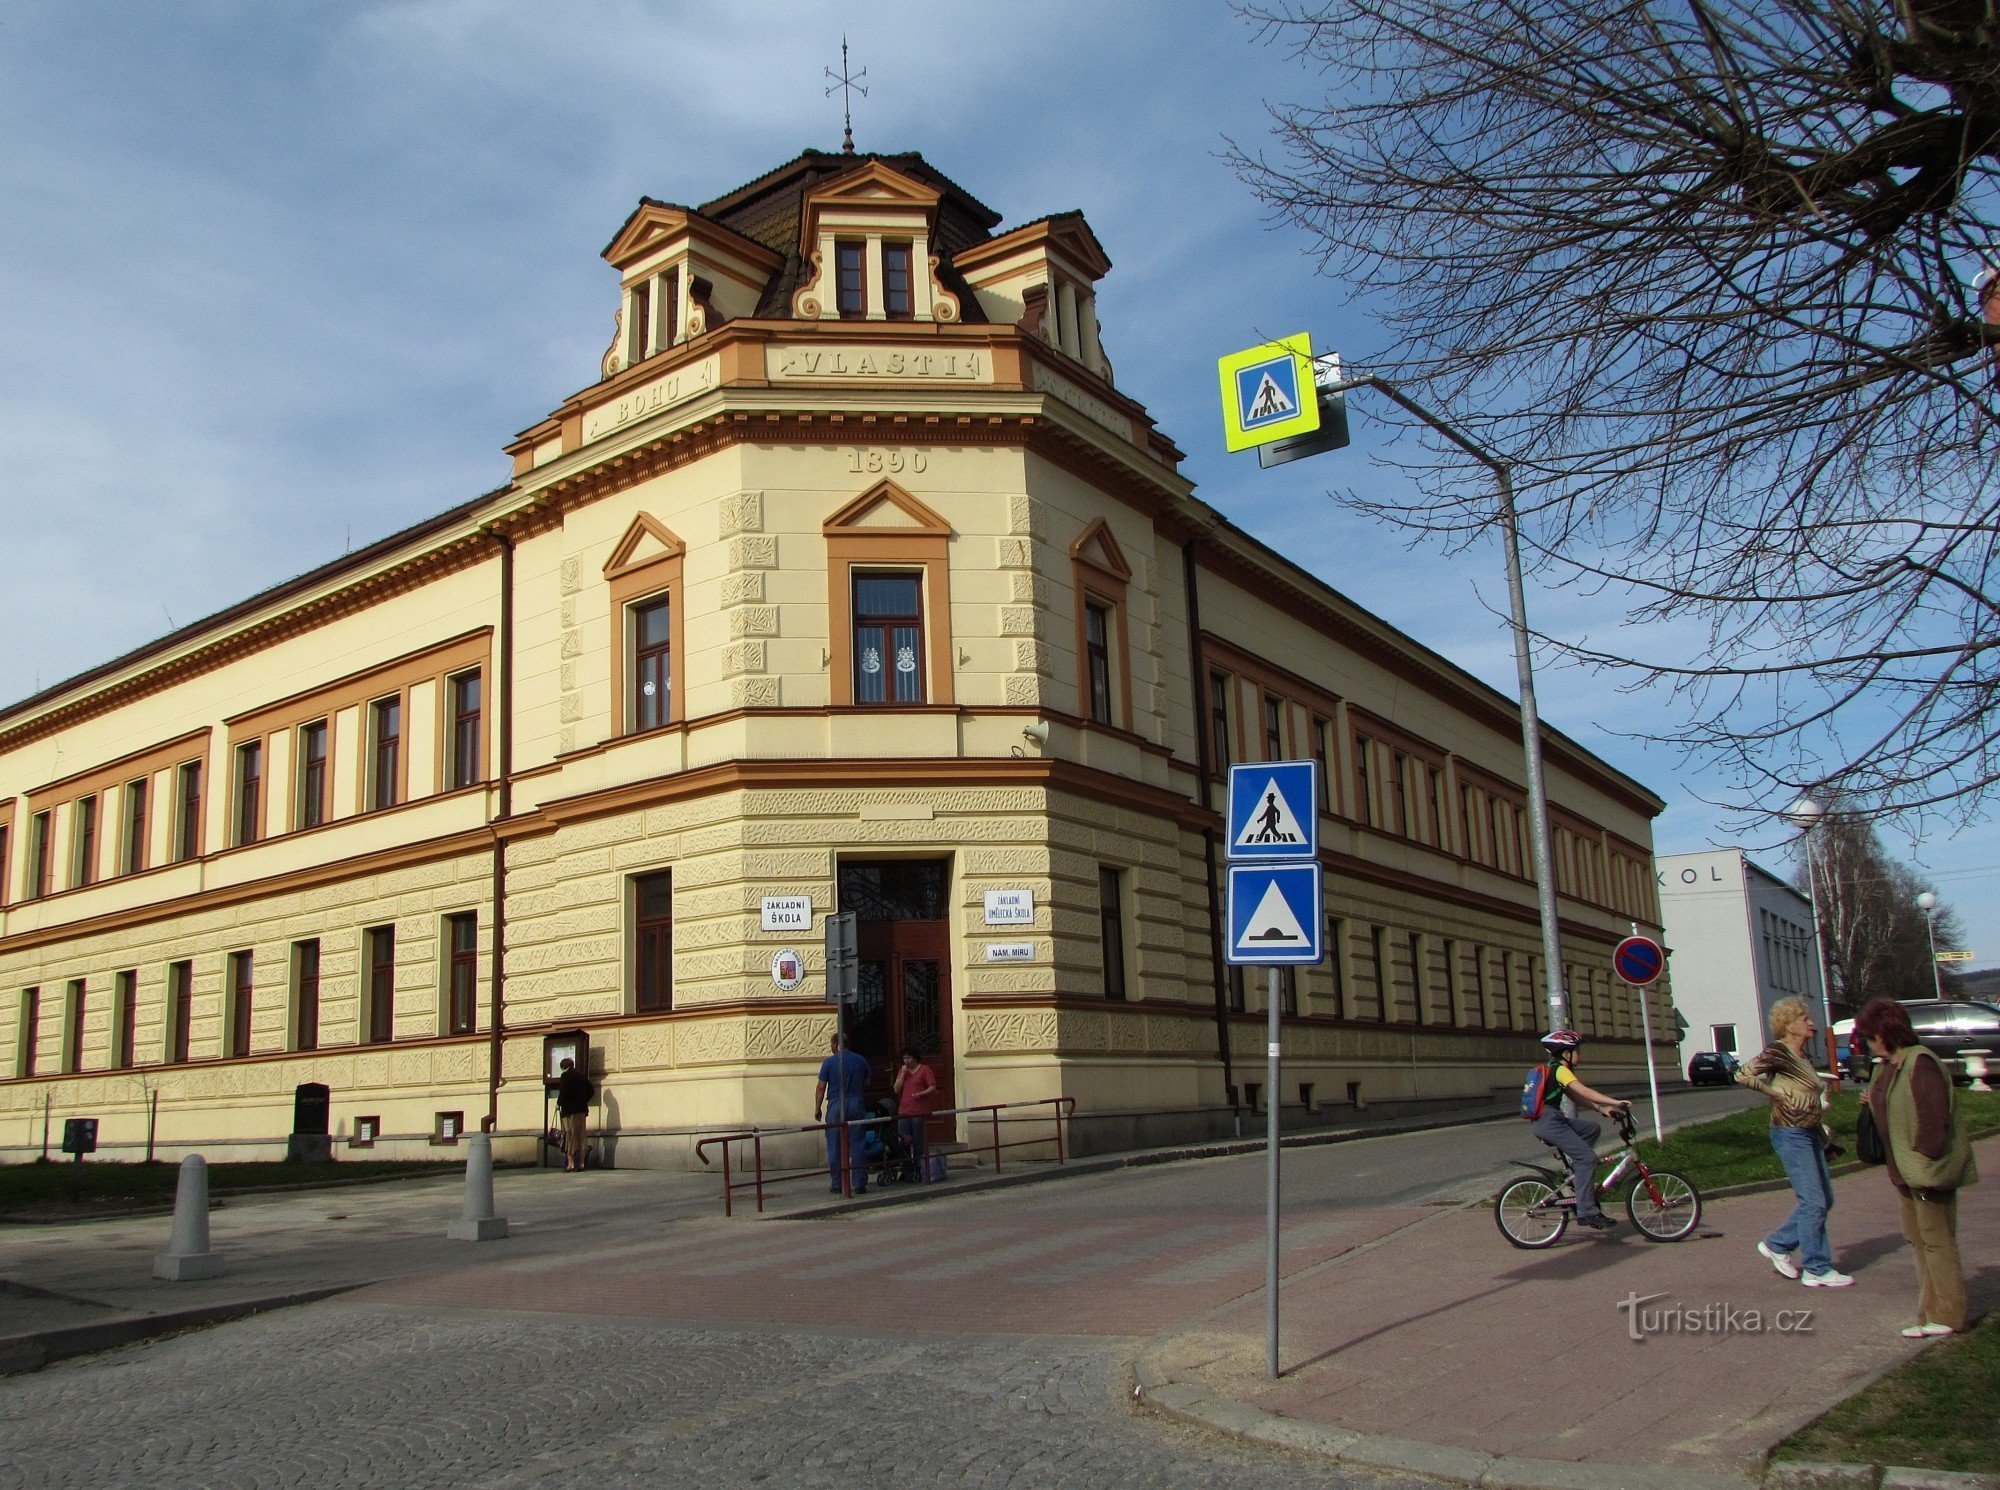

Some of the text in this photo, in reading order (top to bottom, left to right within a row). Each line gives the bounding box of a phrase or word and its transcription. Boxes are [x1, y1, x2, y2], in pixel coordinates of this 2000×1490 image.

[801, 353, 957, 376] VLASTI
[617, 377, 679, 424] BOHU
[848, 451, 928, 474] 1890
[771, 911, 801, 923] ŠKOLA
[1014, 906, 1030, 918] ŠKOLA
